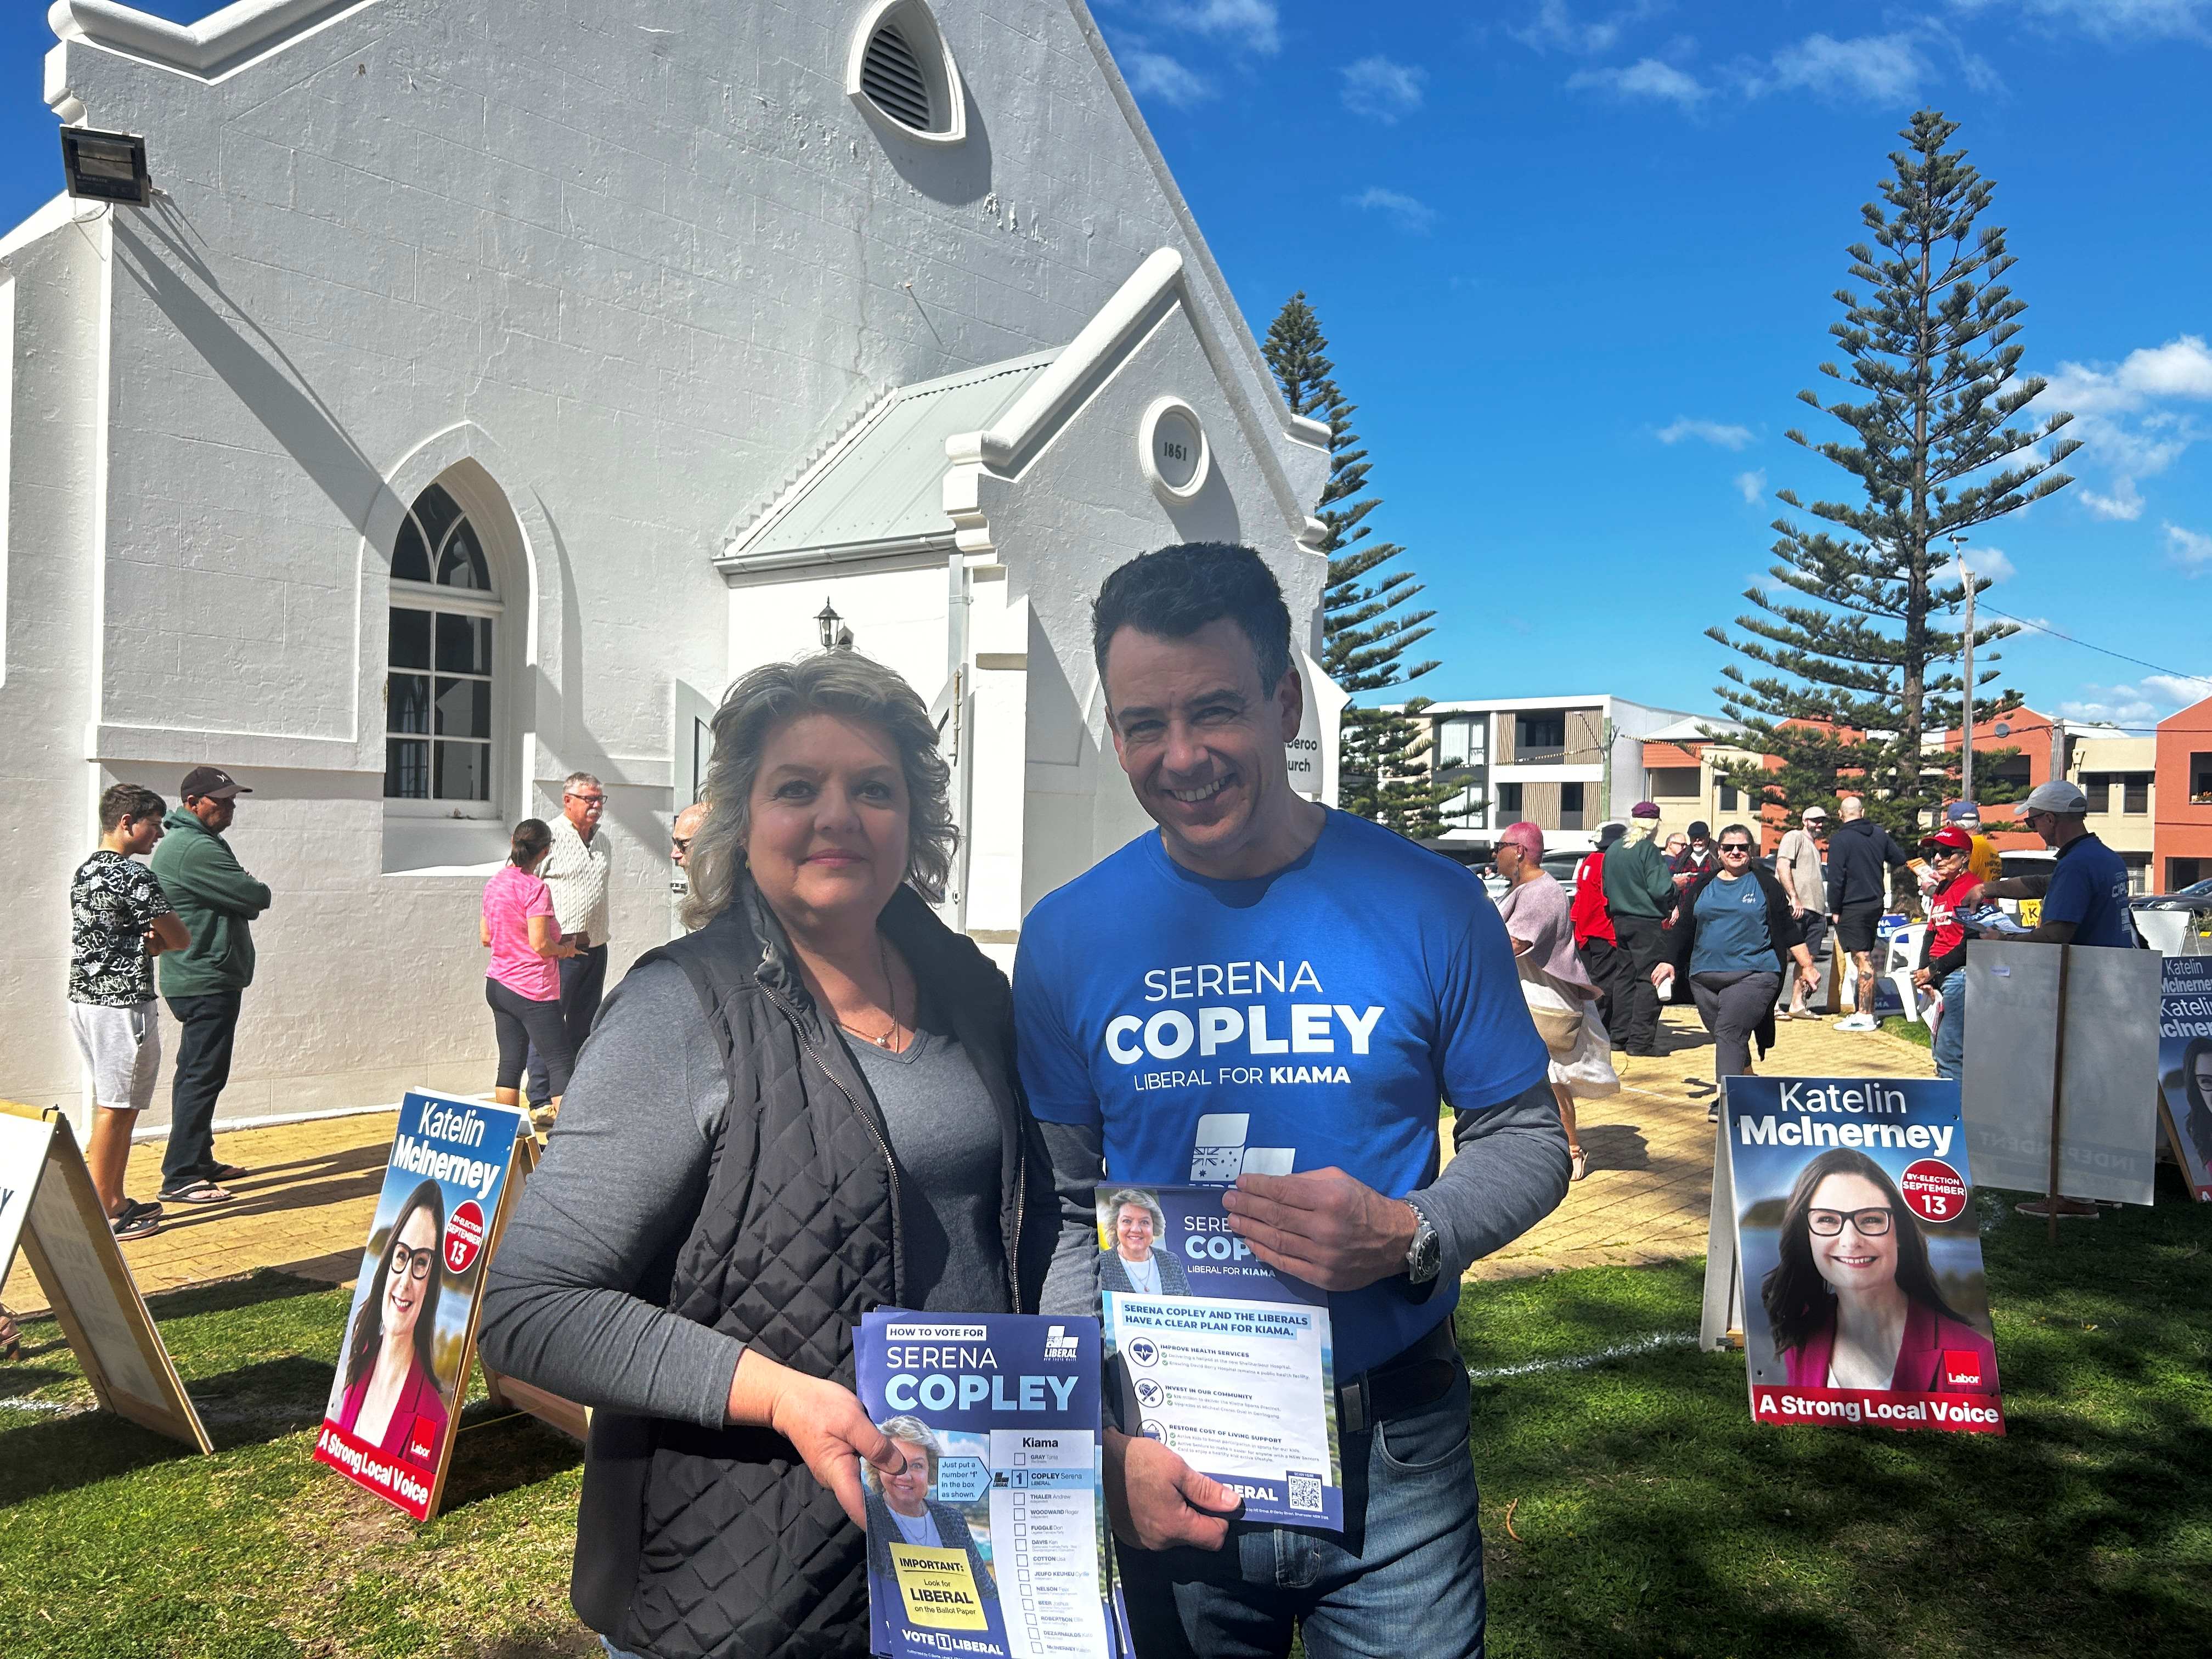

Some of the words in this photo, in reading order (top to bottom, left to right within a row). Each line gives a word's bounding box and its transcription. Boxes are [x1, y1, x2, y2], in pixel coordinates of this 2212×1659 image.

[1164, 442, 1187, 461] 1851
[1288, 758, 1310, 772] urch
[2165, 958, 2203, 975] Katelin
[1144, 960, 1324, 1002] SERENA
[1105, 1003, 1386, 1065] COPLEY
[1133, 1069, 1211, 1091] LIBERAL
[1219, 1066, 1263, 1085] FOR
[1269, 1066, 1351, 1084] KIAMA
[1779, 1081, 1907, 1114] Katelin
[418, 1101, 485, 1147] Katelin
[1739, 1115, 1954, 1156] McInerney
[392, 1133, 501, 1200] McInerney
[1902, 1180, 1965, 1196] SEPTEMBER
[1906, 1172, 1960, 1186] BY-ELECTION
[1921, 1195, 1947, 1215] 13
[453, 1214, 482, 1234] BY-ELECTION
[1184, 1216, 1233, 1232] SERE
[448, 1222, 482, 1246] SEPTEMBER
[450, 1240, 467, 1265] 13
[1185, 1235, 1256, 1261] COP
[1187, 1265, 1222, 1274] LIBERAL
[1223, 1267, 1240, 1275] FOR
[1242, 1267, 1276, 1277] KIAMA
[1125, 1305, 1164, 1314] SERENA
[1166, 1308, 1206, 1317] COPLEY
[1209, 1311, 1232, 1319] AND
[1234, 1312, 1255, 1321] THE
[1258, 1313, 1307, 1325] LIBERALS
[1126, 1316, 1152, 1324] HAVE
[1165, 1319, 1198, 1328] CLEAR
[1200, 1322, 1228, 1331] PLAN
[1231, 1324, 1252, 1333] FOR
[1256, 1325, 1294, 1336] KIAMA.
[886, 1346, 998, 1369] SERENA
[1044, 1347, 1077, 1358] LIBERAL
[1948, 1372, 1980, 1384] Labor
[885, 1373, 1079, 1410] COPLEY
[1214, 1391, 1252, 1400] COMMUNITY
[1759, 1395, 1778, 1414] A
[1781, 1396, 1860, 1422] Strong
[1864, 1399, 1927, 1420] Local
[1929, 1401, 1999, 1423] Voice
[1023, 1437, 1059, 1448] Kiama
[1169, 1424, 1198, 1432] RESTORE
[1251, 1435, 1282, 1443] SUPPORT
[410, 1440, 430, 1458] Labor
[319, 1429, 329, 1450] A
[328, 1434, 363, 1474] Strong
[361, 1452, 393, 1487] Local
[393, 1468, 428, 1505] Voice
[958, 1462, 969, 1470] put
[1016, 1472, 1022, 1484] 1
[1222, 1483, 1279, 1502] ERAL
[899, 1558, 964, 1572] IMPORTANT:
[910, 1588, 974, 1604] LIBERAL
[956, 1607, 976, 1616] Paper
[901, 1629, 935, 1645] VOTE
[940, 1636, 947, 1647] 1
[952, 1638, 1004, 1656] LIBERAL
